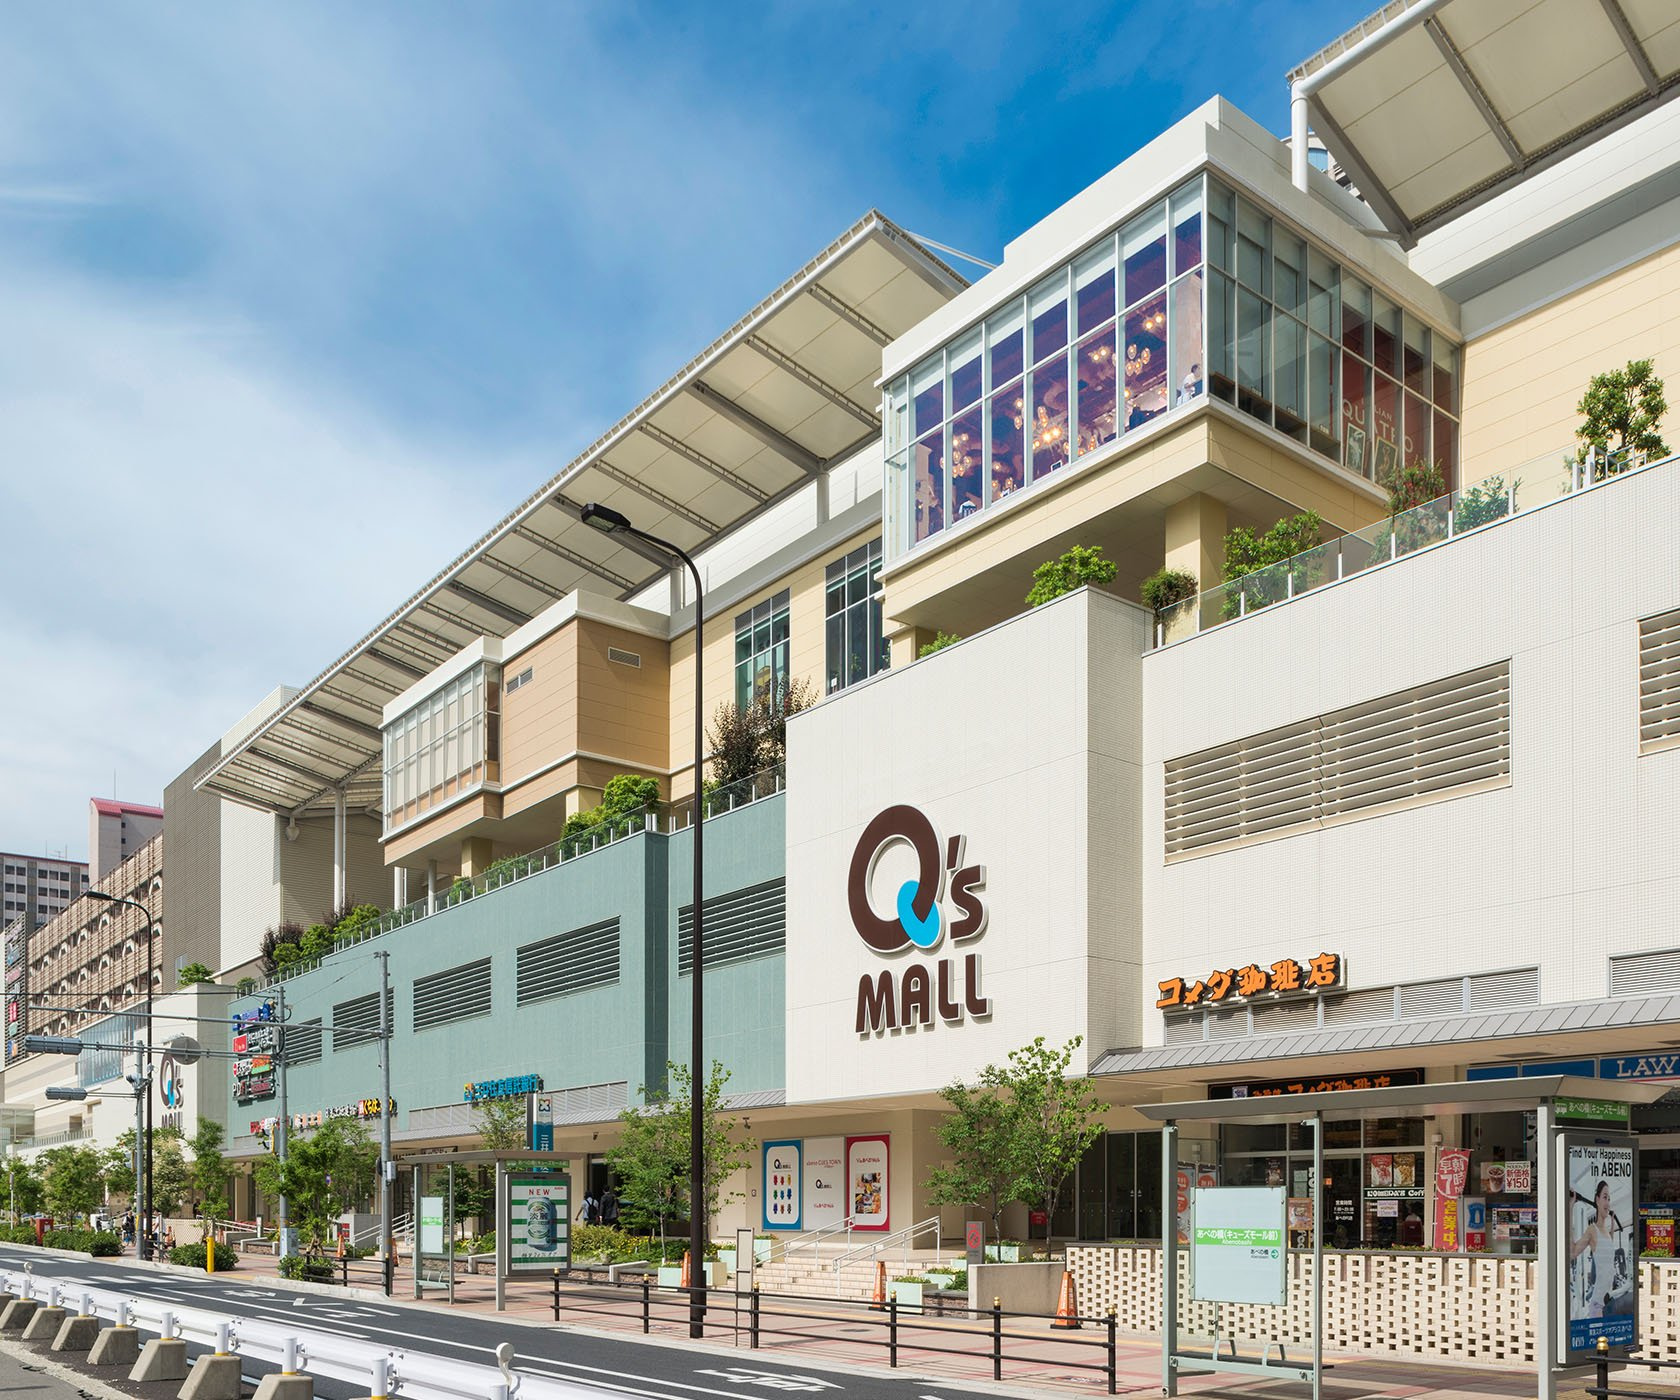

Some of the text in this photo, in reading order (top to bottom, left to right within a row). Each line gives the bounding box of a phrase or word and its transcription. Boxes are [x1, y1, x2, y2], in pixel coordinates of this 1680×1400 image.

[848, 804, 989, 953] Q's
[1156, 952, 1339, 1008] コメダ珈琲店
[855, 953, 993, 1035] MALL
[1569, 1147, 1631, 1161] Find Your Happiness
[1591, 1162, 1632, 1177] in ABENO
[1506, 1178, 1529, 1189] ¥150
[1197, 1229, 1278, 1241] あべの橋(キューズモール前)
